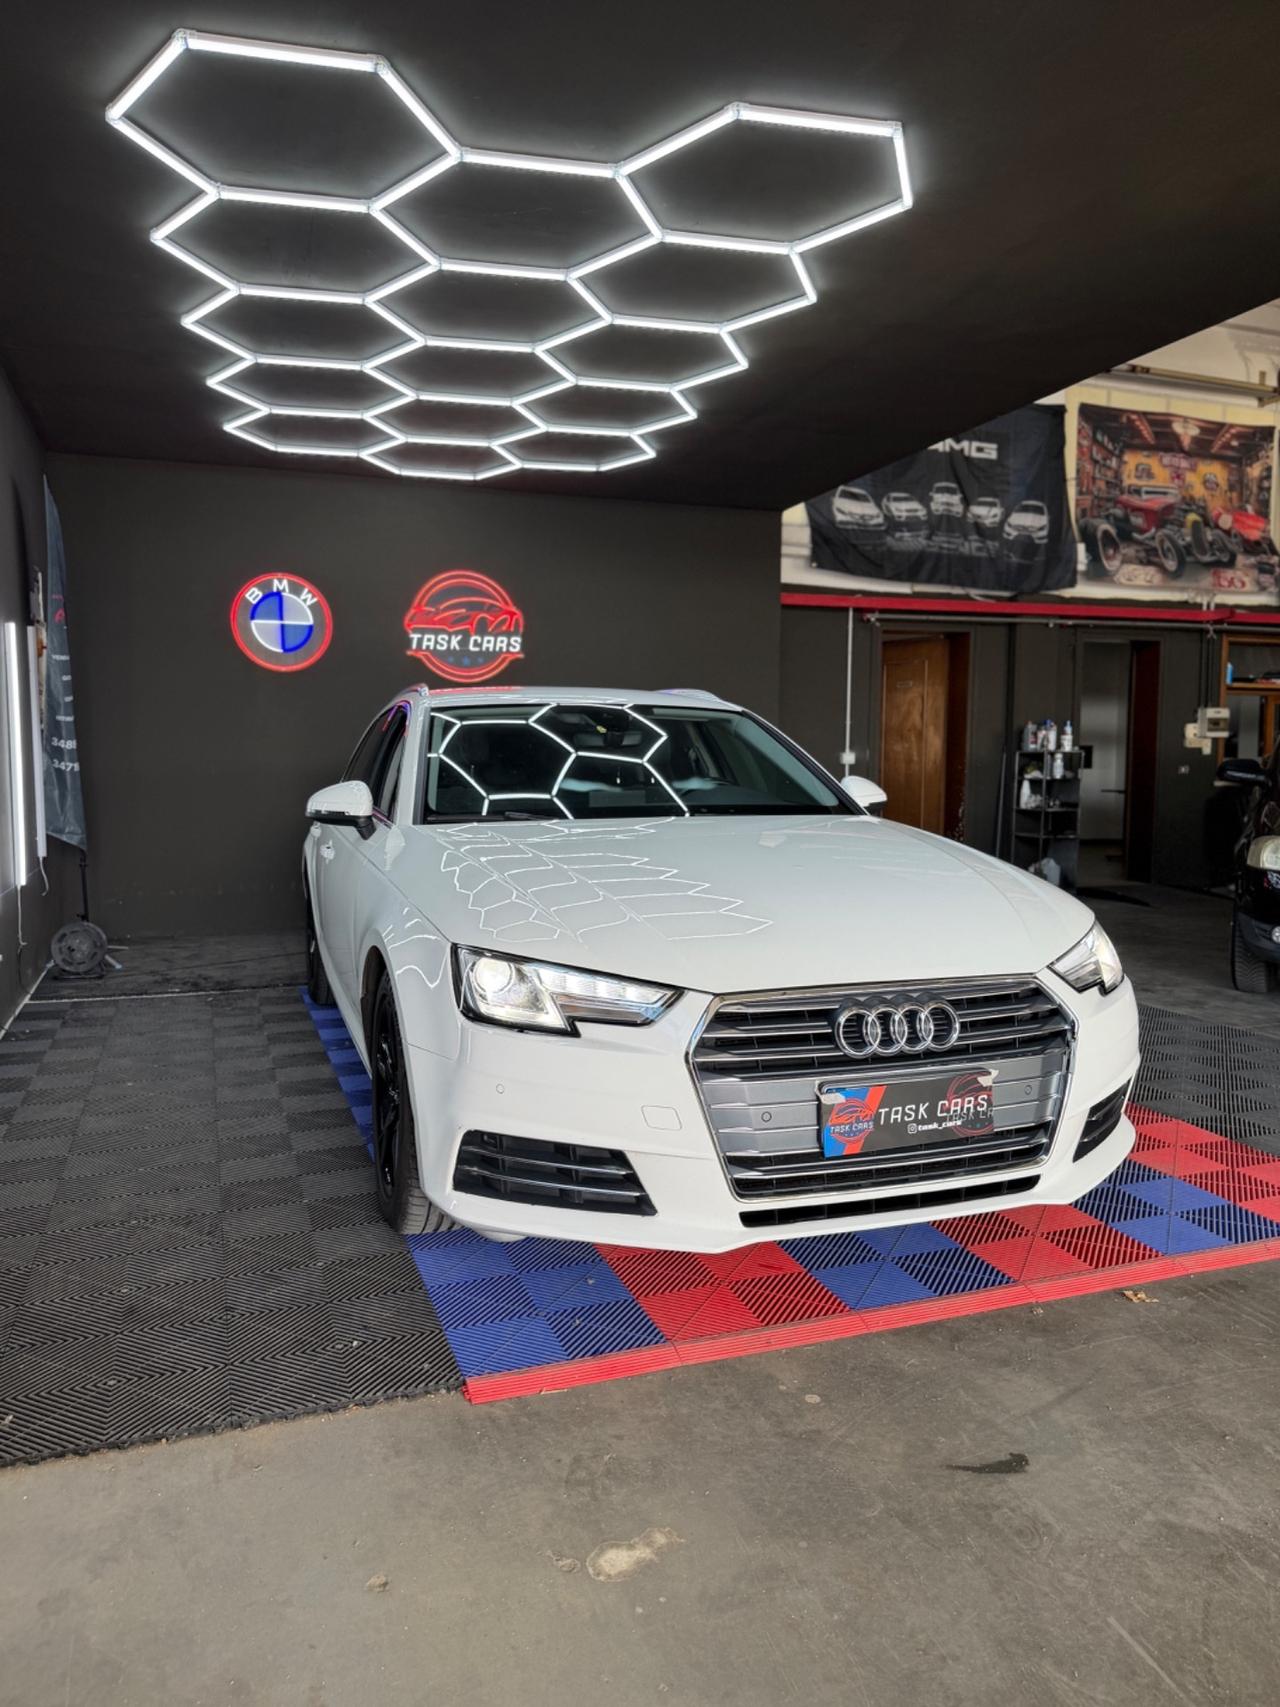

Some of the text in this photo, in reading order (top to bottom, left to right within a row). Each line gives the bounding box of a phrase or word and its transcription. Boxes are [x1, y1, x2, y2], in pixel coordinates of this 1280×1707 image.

[245, 579, 317, 606] BMW
[409, 634, 522, 652] TASK CARS
[878, 1094, 988, 1125] TASK CARS
[830, 1120, 874, 1134] TASK CARS
